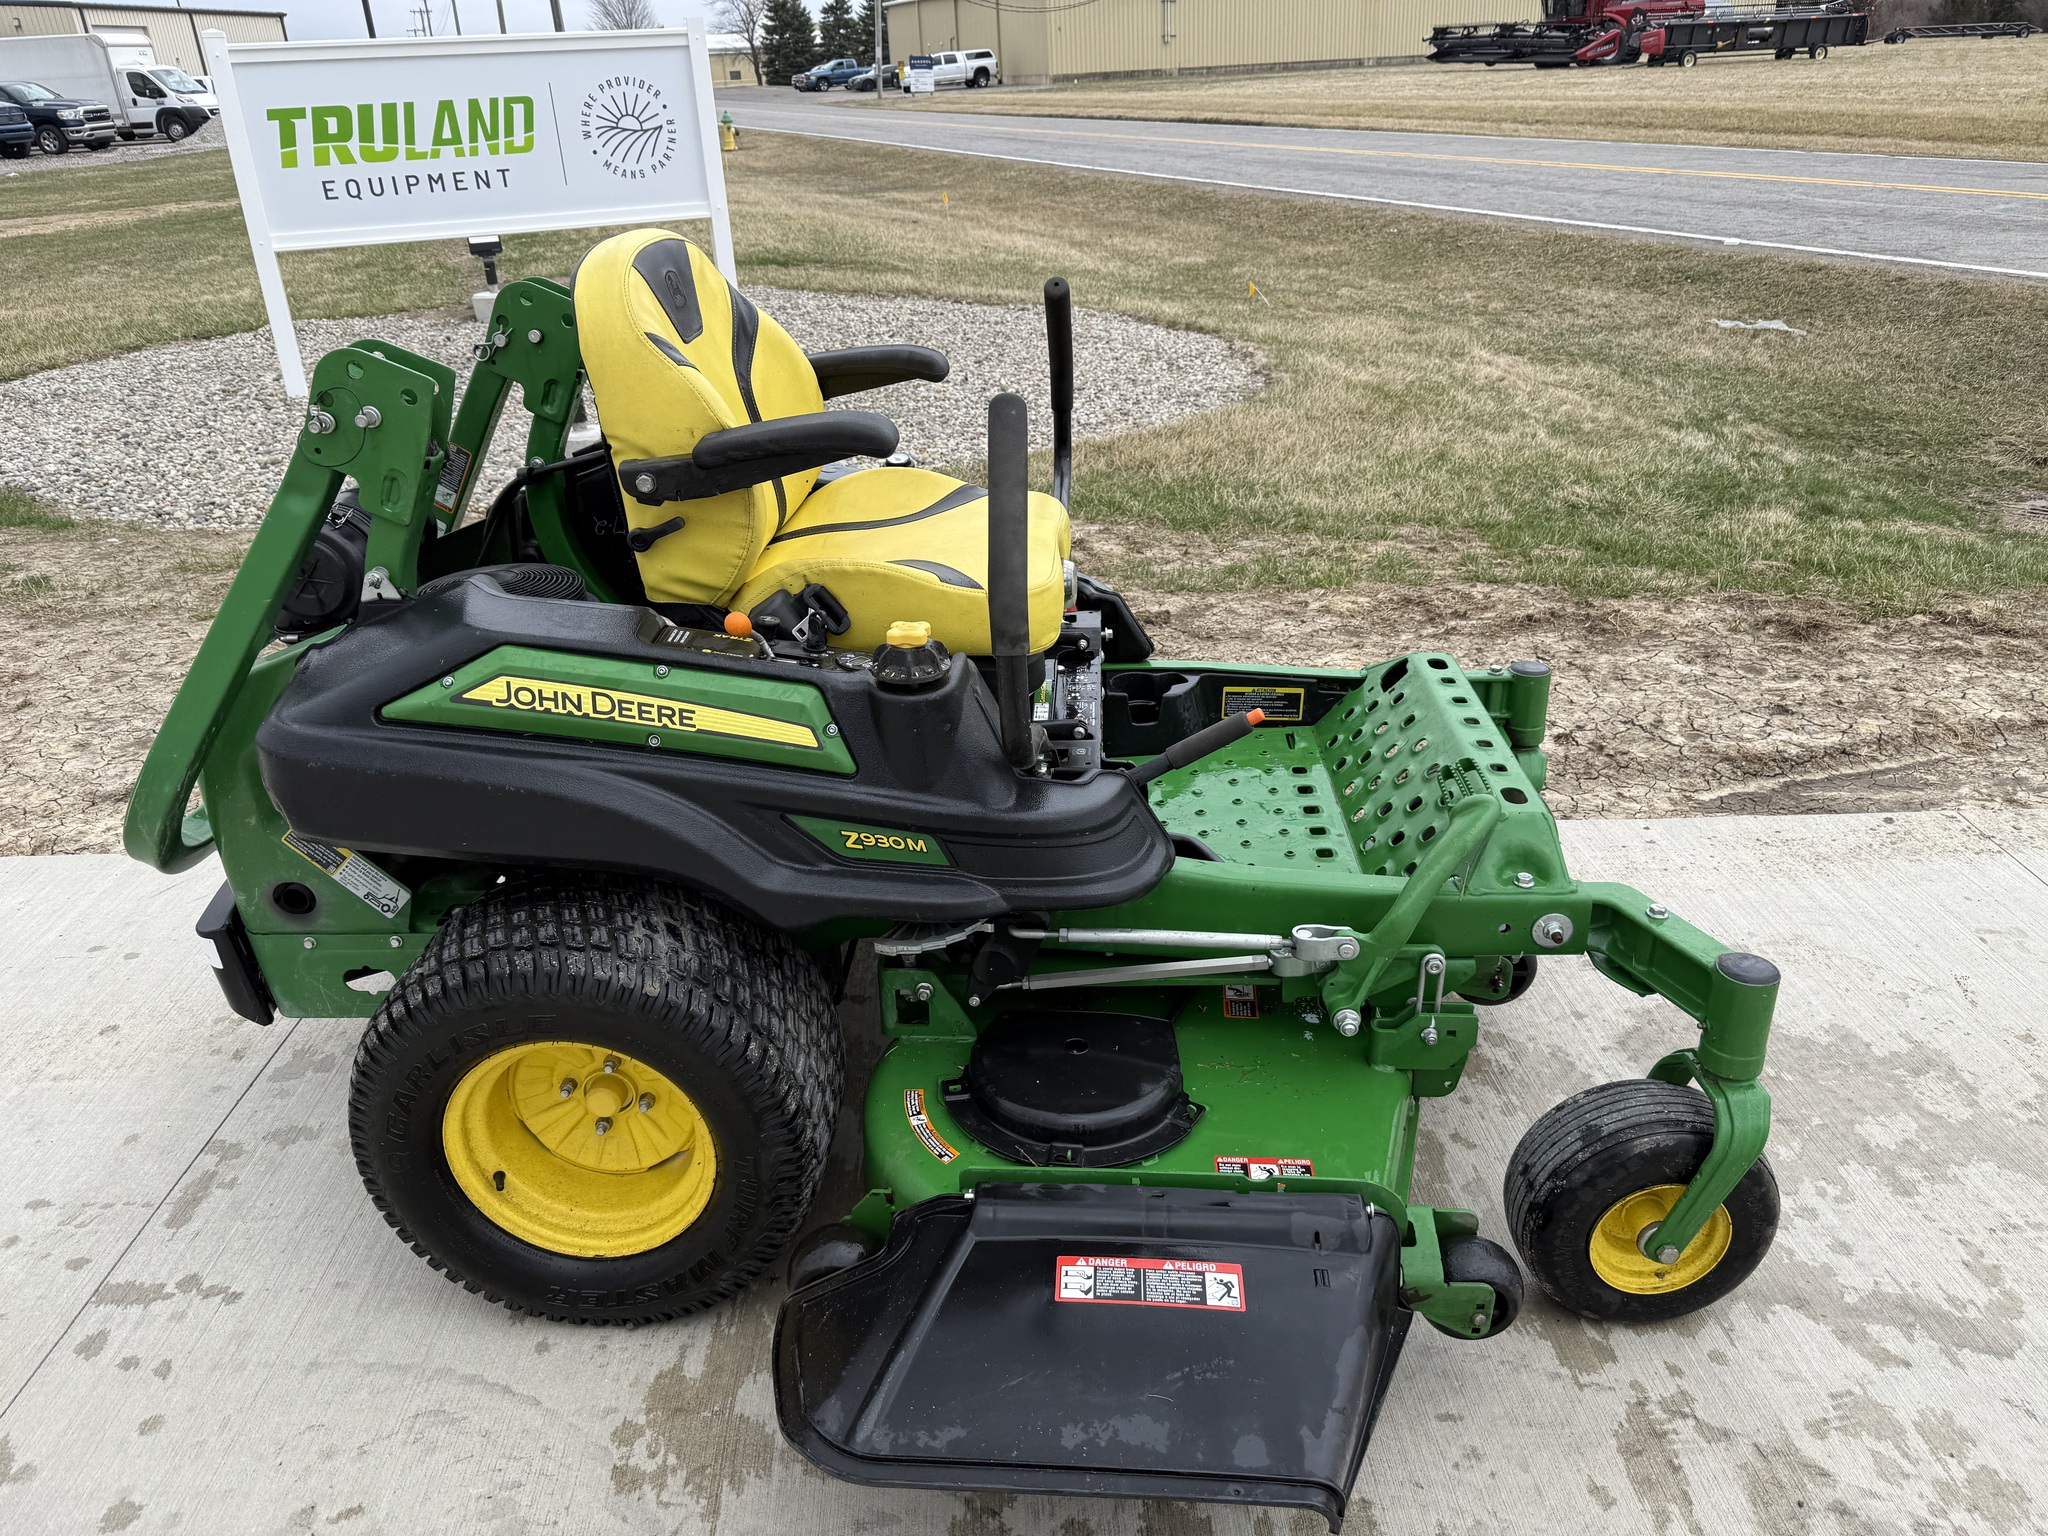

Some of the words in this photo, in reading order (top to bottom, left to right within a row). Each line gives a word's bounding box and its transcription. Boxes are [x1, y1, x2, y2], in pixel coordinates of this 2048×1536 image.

[266, 95, 534, 169] TRULAND
[581, 93, 598, 140] WHERE
[598, 76, 661, 99] PROVIDER
[602, 159, 646, 179] MEANS
[650, 118, 677, 173] PARTNER
[321, 168, 511, 201] EQUIPMENT
[495, 681, 582, 714] JOHN
[591, 692, 697, 728] DEERE
[840, 830, 928, 853] Z930M
[386, 1014, 557, 1143] CARLISLE
[723, 1156, 759, 1253] TURF
[544, 1249, 724, 1310] MASTER
[1088, 1258, 1128, 1267] DANGER
[1175, 1261, 1217, 1272] PELIGRO
